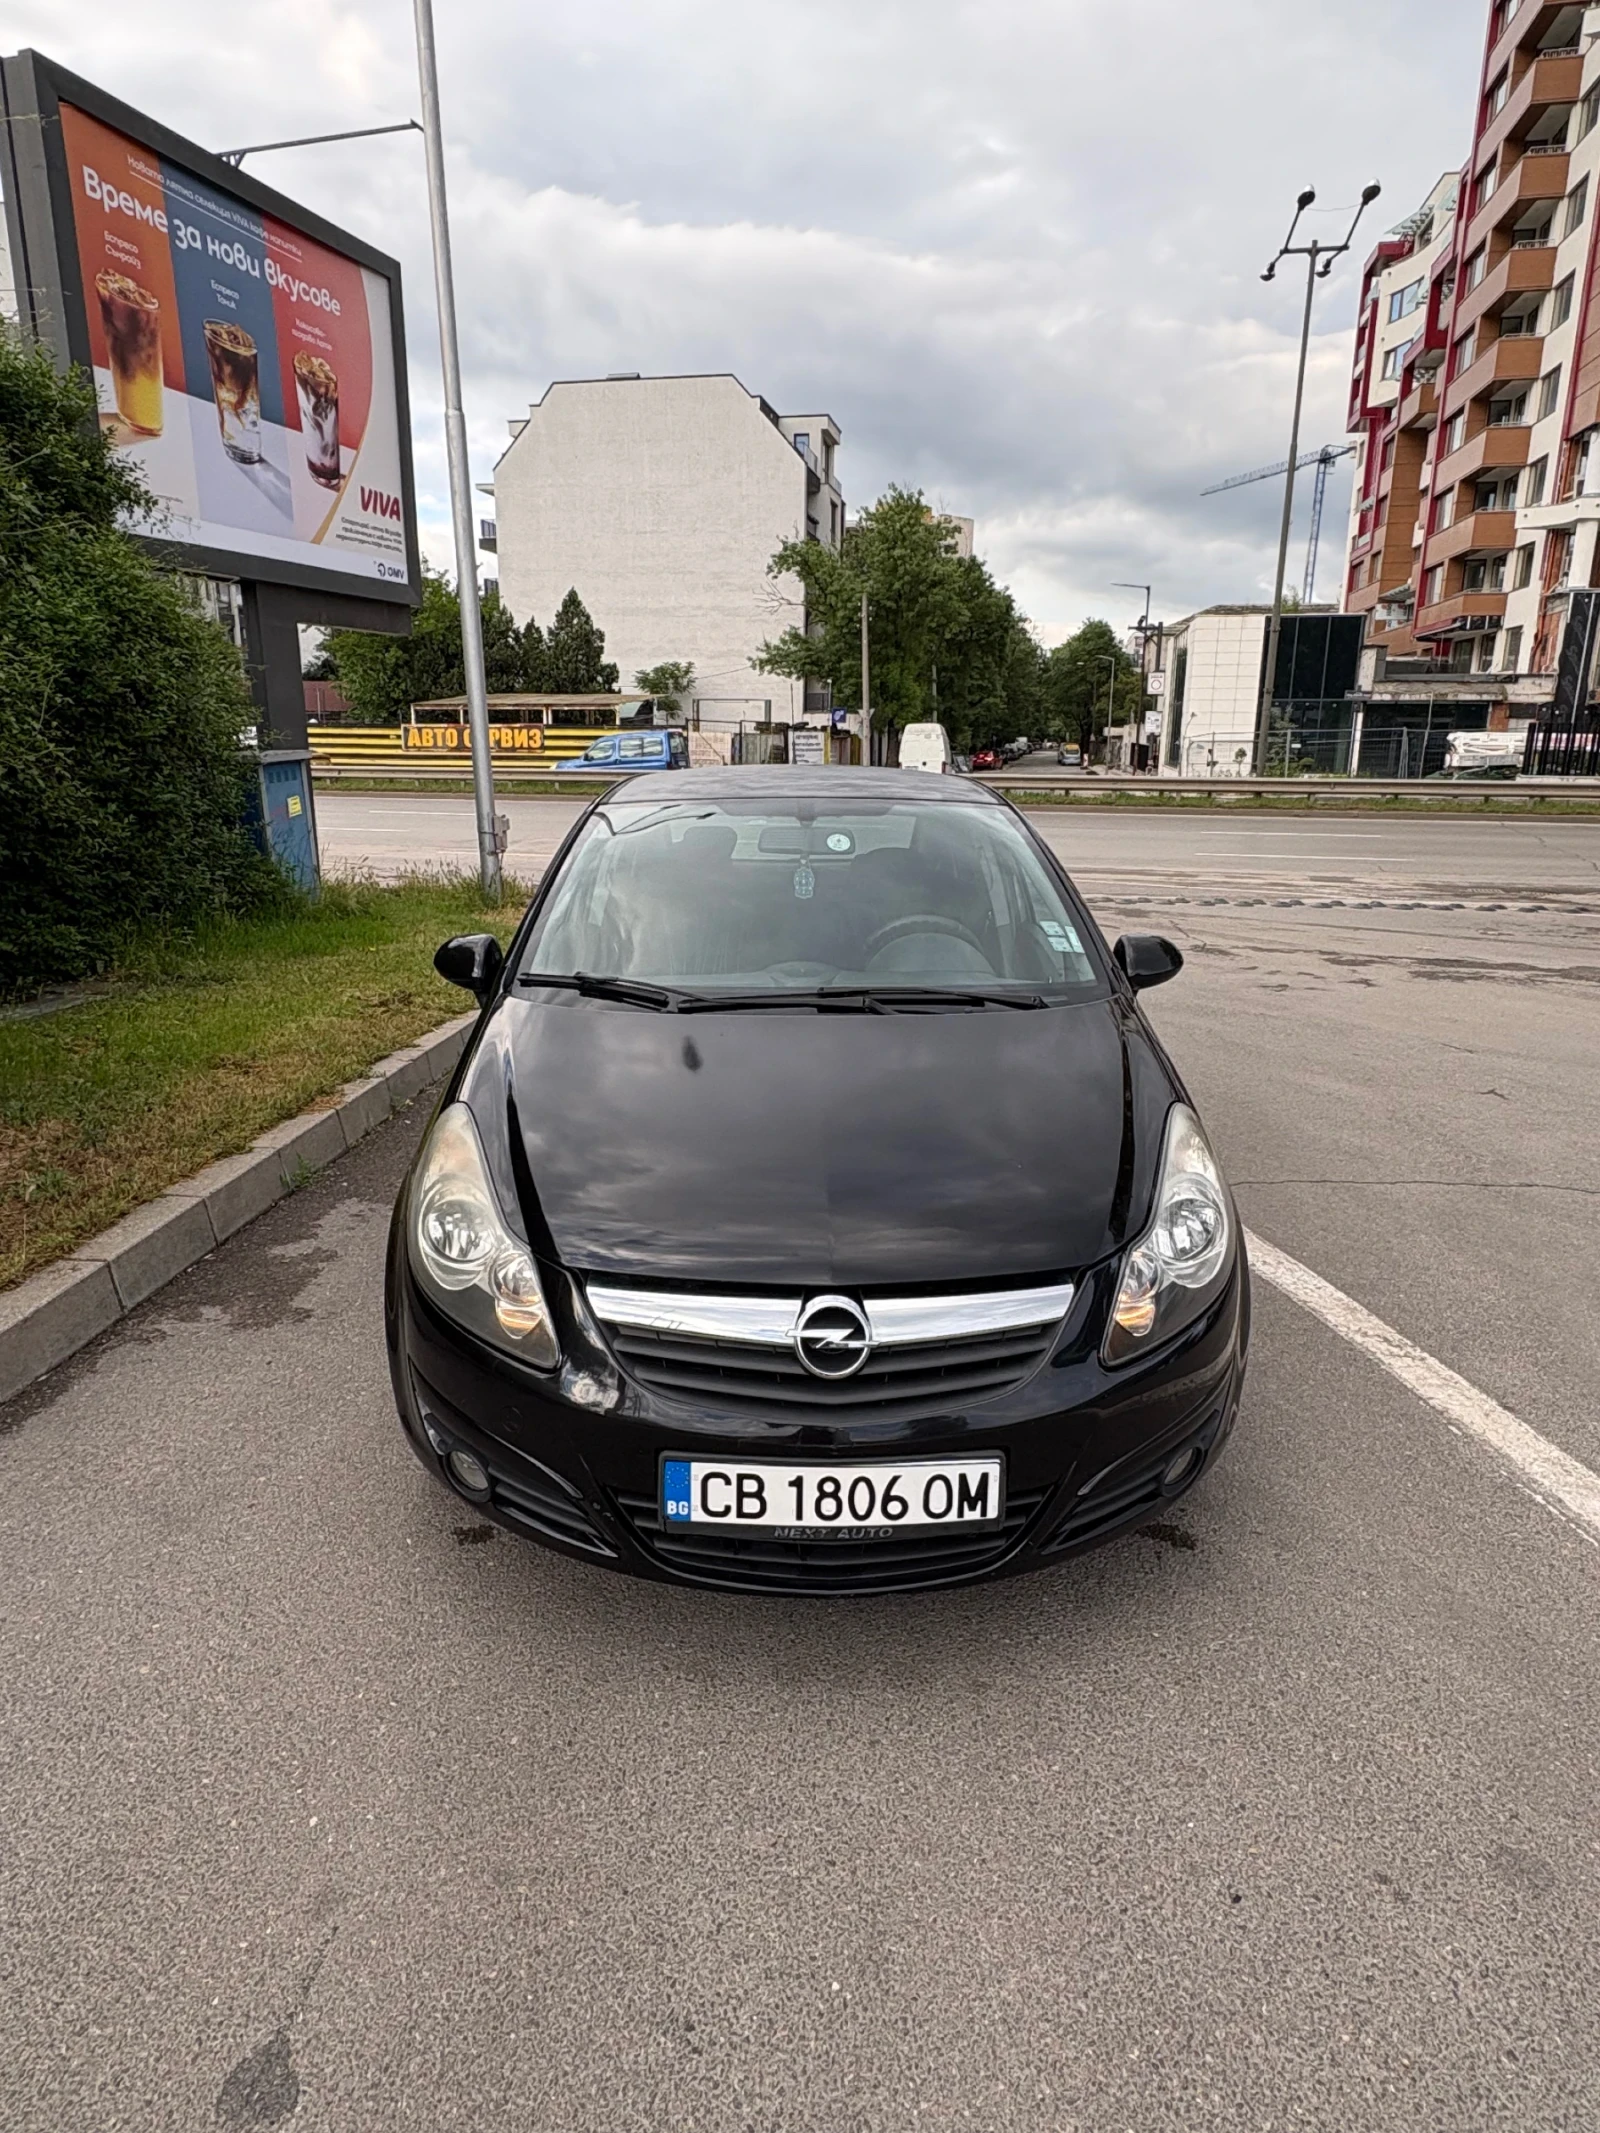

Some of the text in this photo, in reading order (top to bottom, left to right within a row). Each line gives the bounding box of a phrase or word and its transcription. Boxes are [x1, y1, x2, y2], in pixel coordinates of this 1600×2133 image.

[82, 164, 341, 316] Време за нови вкусове
[360, 485, 401, 523] VIVA
[387, 566, 405, 580] OMV
[407, 728, 542, 749] АВТО СРВИЗ
[700, 1471, 989, 1521] CB 1806 OM
[667, 1500, 689, 1515] BG
[774, 1526, 893, 1539] NEXT AUTO
